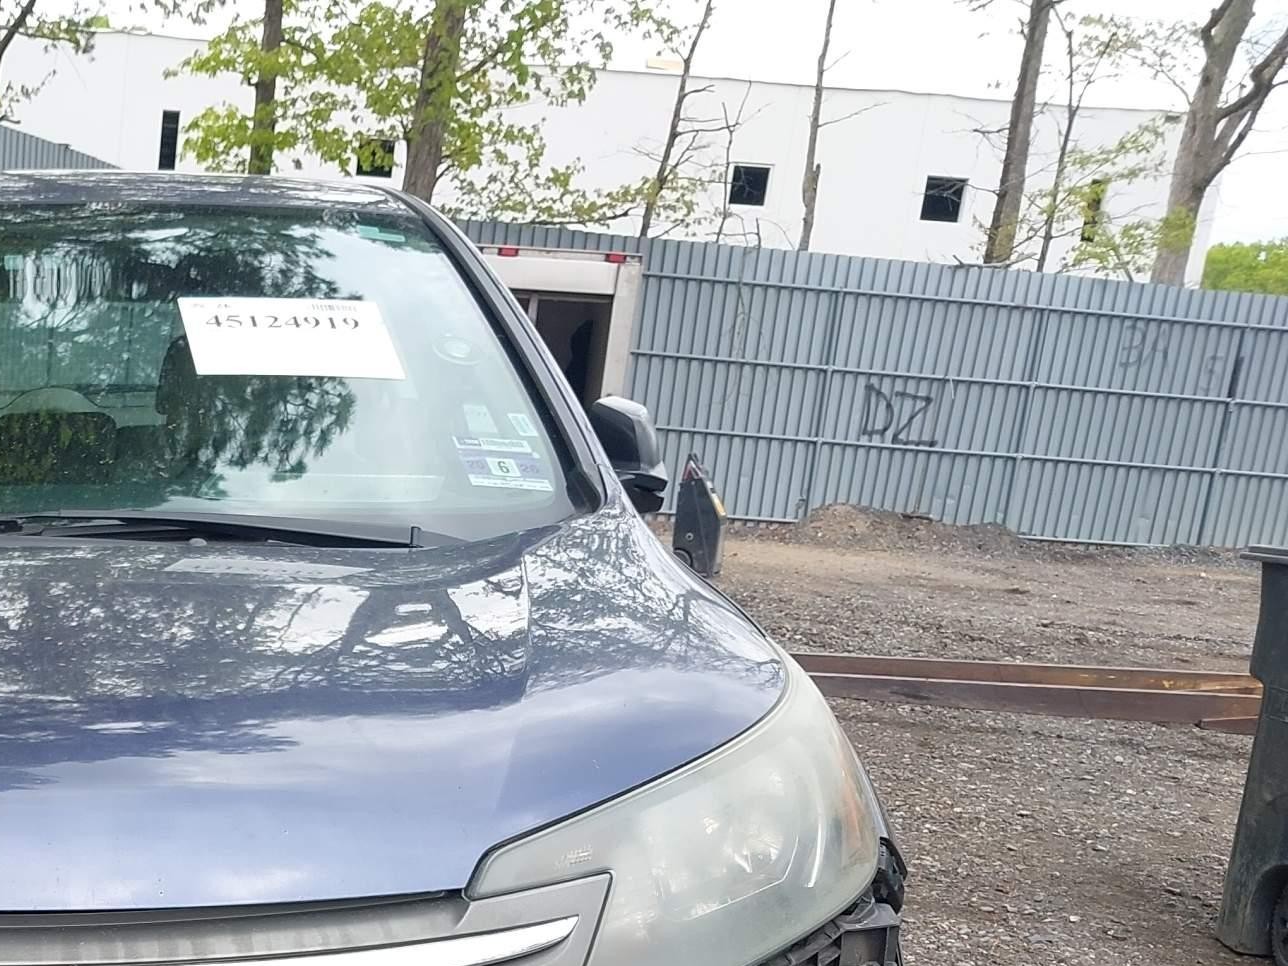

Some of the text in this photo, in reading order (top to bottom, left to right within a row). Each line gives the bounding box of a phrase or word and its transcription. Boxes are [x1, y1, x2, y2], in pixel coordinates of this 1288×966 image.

[205, 314, 360, 330] 45124919
[862, 383, 938, 447] DZ
[496, 460, 511, 474] 6
